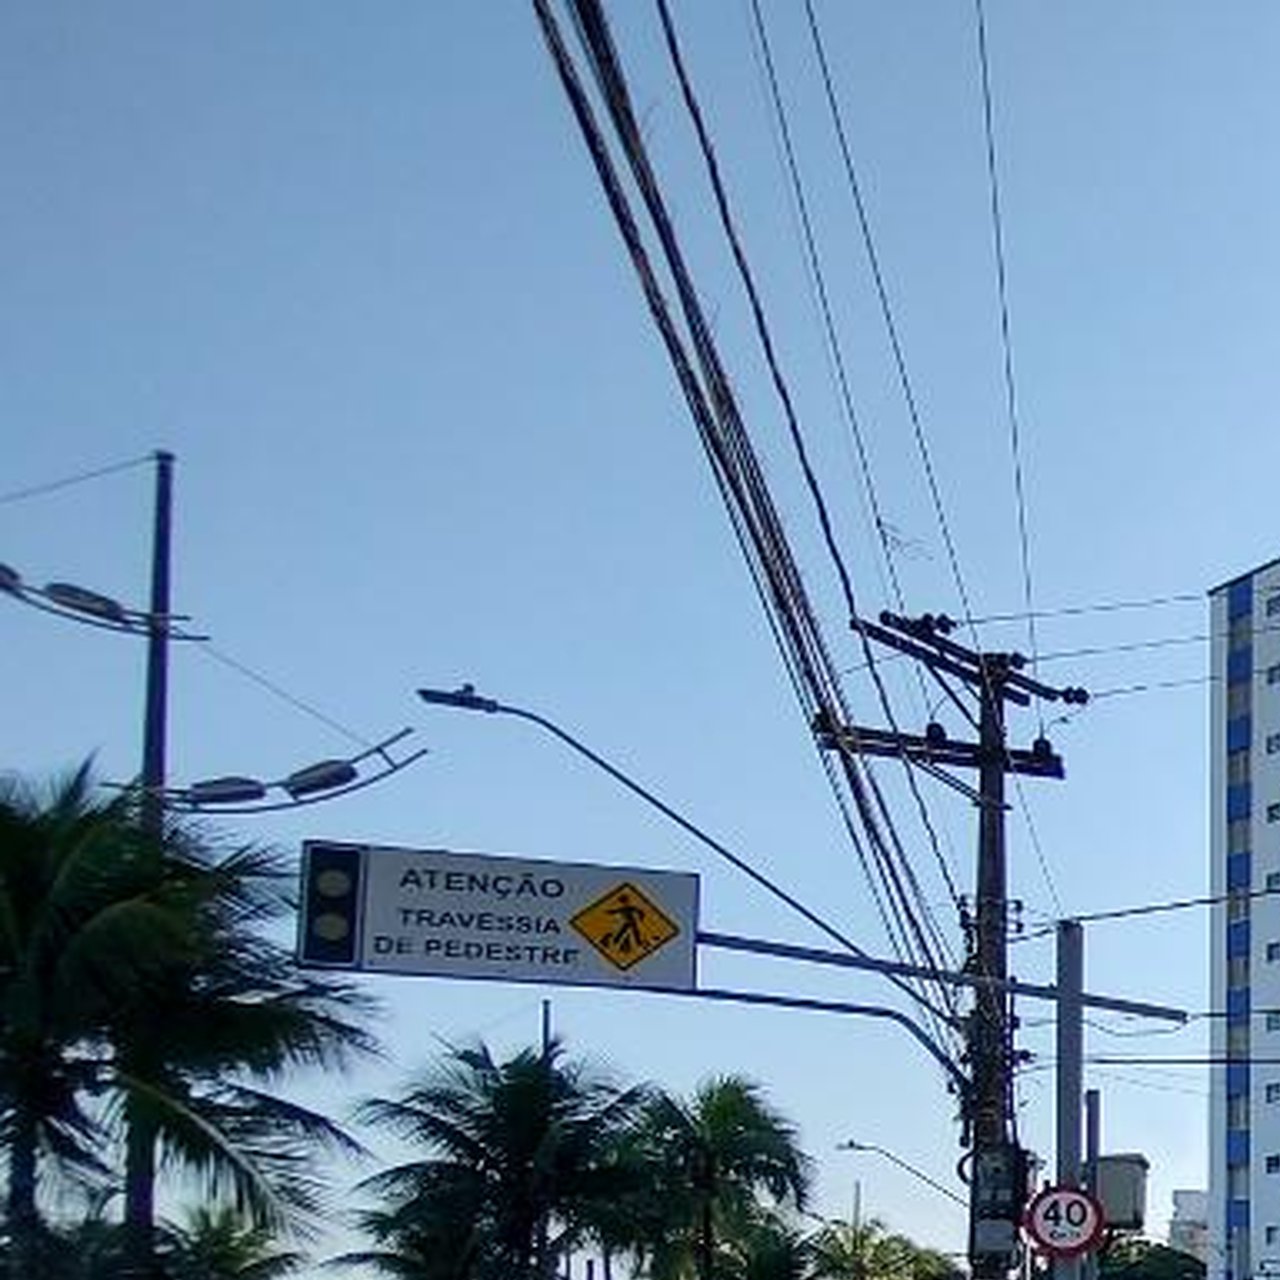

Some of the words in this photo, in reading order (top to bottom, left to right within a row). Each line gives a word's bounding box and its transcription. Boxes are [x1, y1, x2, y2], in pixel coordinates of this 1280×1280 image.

[400, 868, 565, 899] ATENÇÃO
[400, 908, 561, 934] TRAVESSIA
[373, 936, 414, 955] DE
[1043, 1199, 1088, 1227] 40
